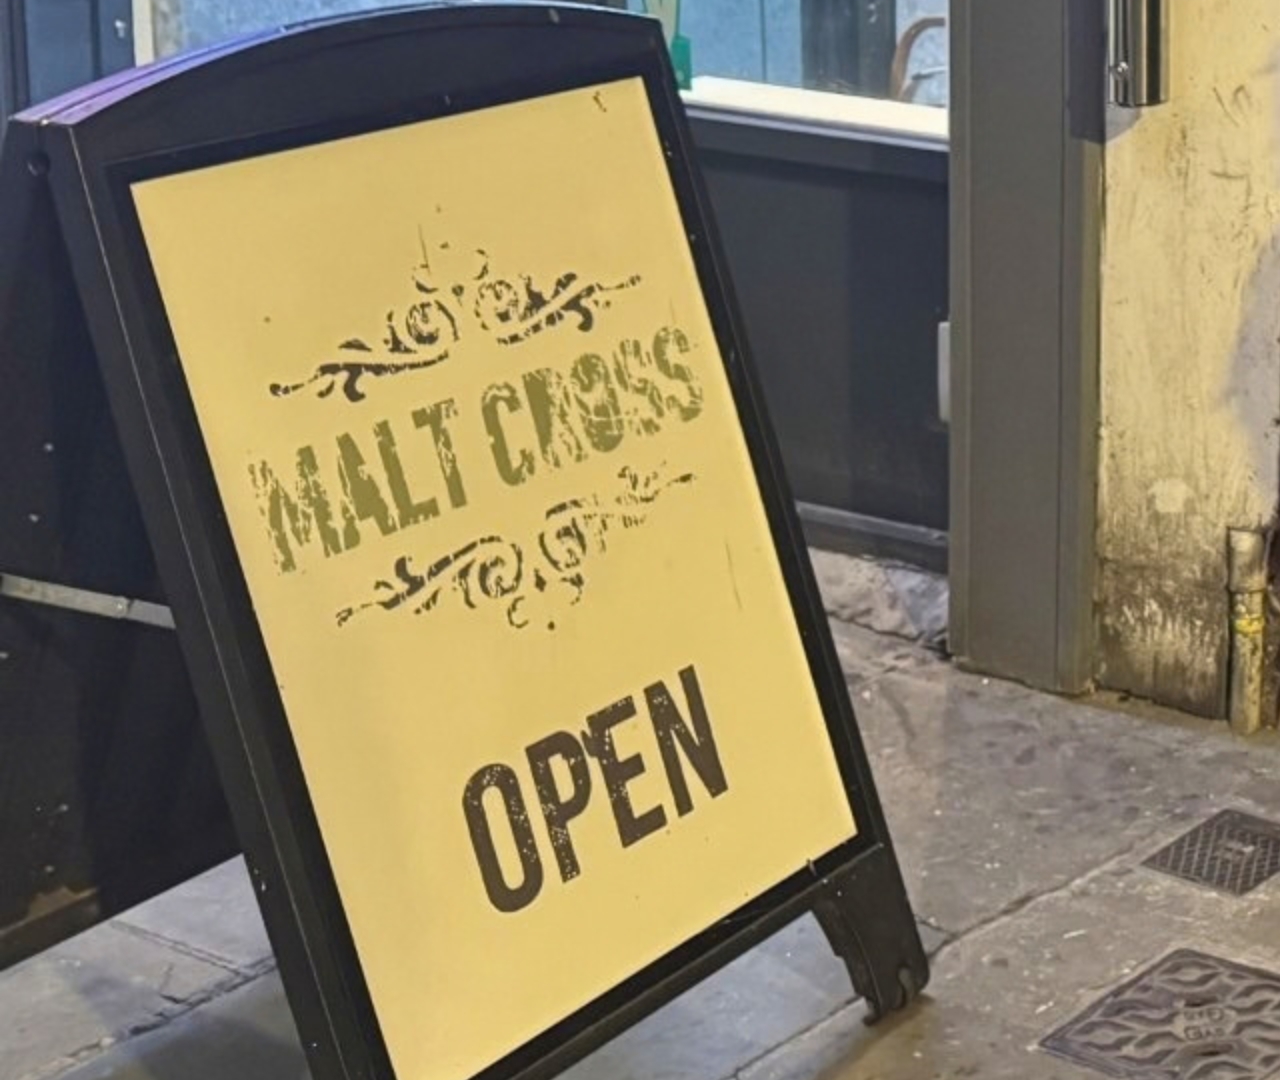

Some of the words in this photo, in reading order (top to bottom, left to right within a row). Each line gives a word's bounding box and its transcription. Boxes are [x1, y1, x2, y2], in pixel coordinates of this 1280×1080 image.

[245, 398, 468, 577] MALT
[480, 325, 706, 488] CROSS
[460, 664, 730, 914] OPEN
